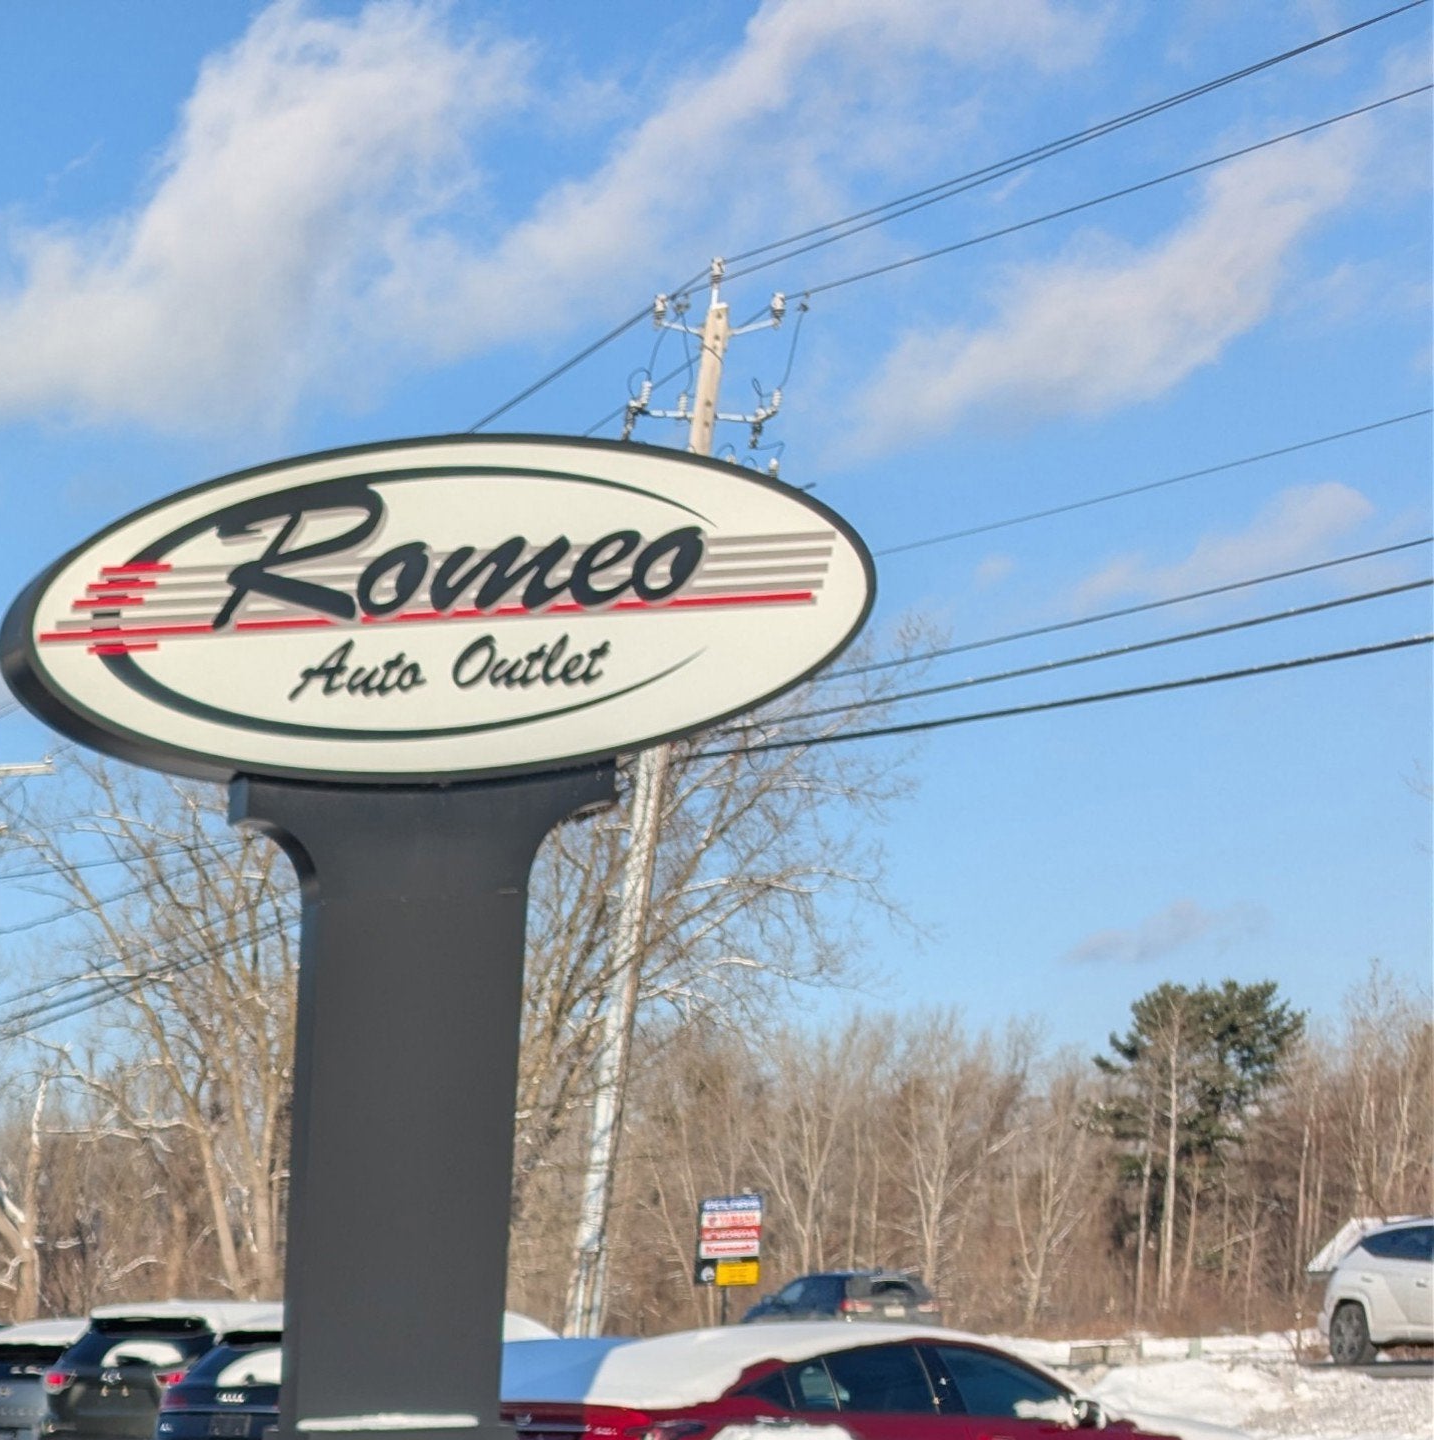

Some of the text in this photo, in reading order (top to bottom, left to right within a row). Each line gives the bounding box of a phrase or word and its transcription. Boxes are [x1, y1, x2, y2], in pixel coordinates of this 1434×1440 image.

[209, 478, 711, 630] Romeo
[289, 636, 611, 701] Auto Outlet
